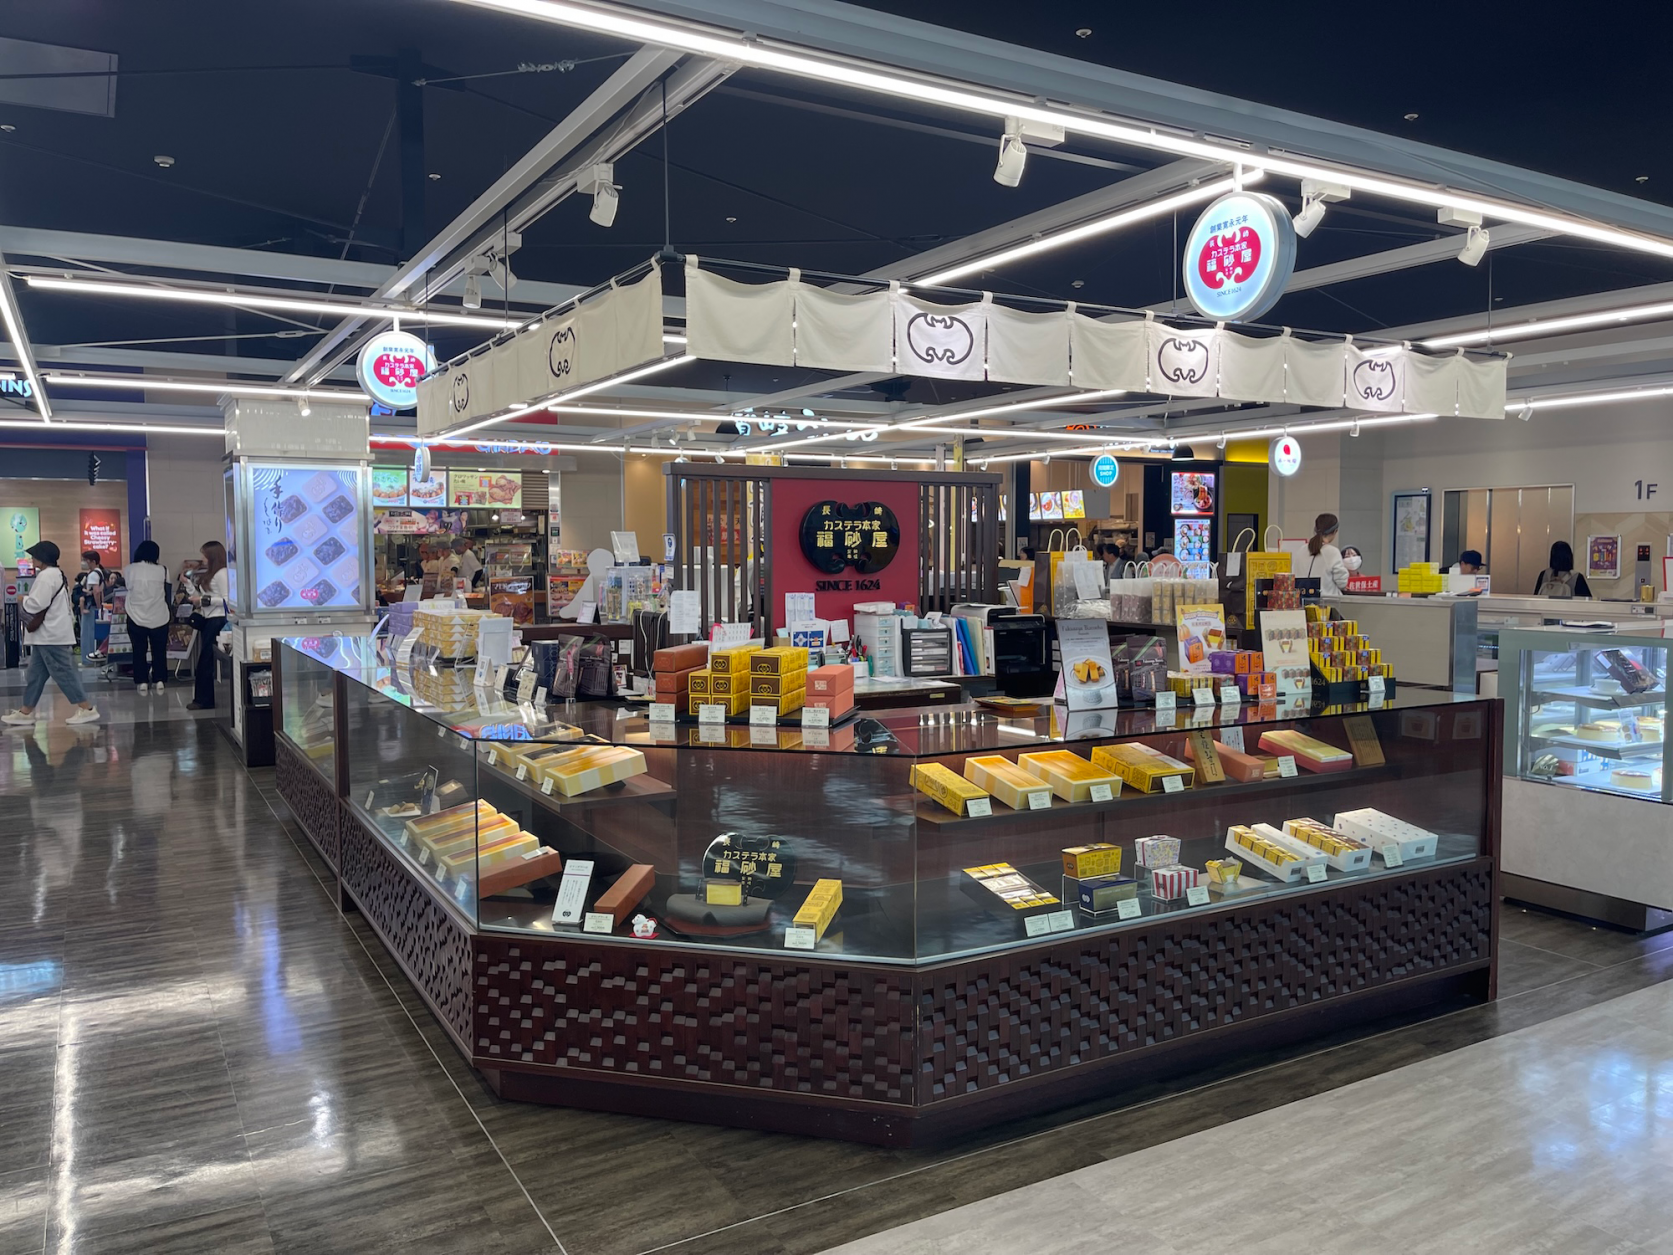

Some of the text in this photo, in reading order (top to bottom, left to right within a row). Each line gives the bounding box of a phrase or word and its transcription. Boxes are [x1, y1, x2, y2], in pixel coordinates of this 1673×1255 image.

[1211, 241, 1248, 258] カステラ本家
[1634, 479, 1658, 500] 1F
[823, 520, 881, 531] カステラ本家
[815, 579, 881, 592] SINCE 1624
[723, 849, 777, 863] カステラ本家
